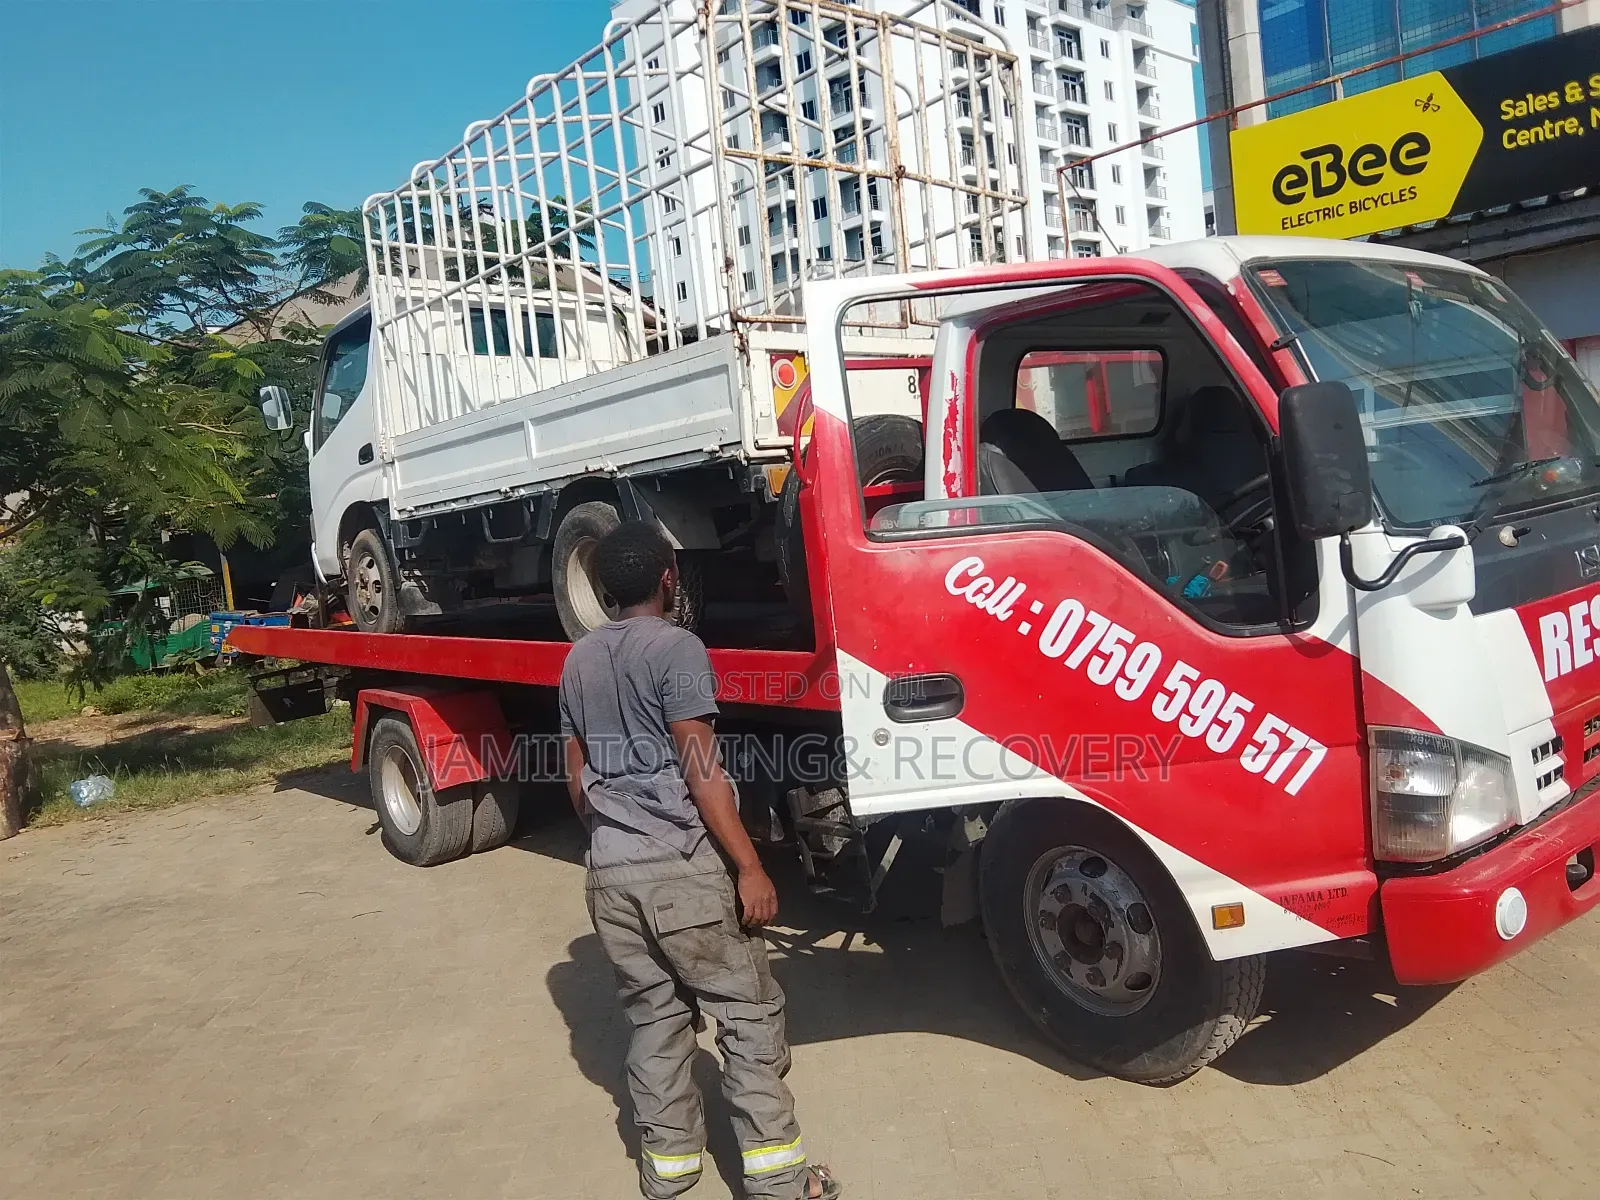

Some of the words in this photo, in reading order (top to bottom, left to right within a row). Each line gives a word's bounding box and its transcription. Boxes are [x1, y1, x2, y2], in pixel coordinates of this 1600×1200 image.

[1500, 91, 1559, 120] Sales
[1565, 81, 1584, 103] &
[1503, 117, 1584, 149] Centre,
[1272, 132, 1431, 206] eBee
[1281, 203, 1345, 231] ELECTRIC
[1349, 186, 1418, 215] BICYCLES
[1039, 599, 1162, 702] 0759
[1152, 660, 1255, 754] 595
[1239, 713, 1329, 797] 577
